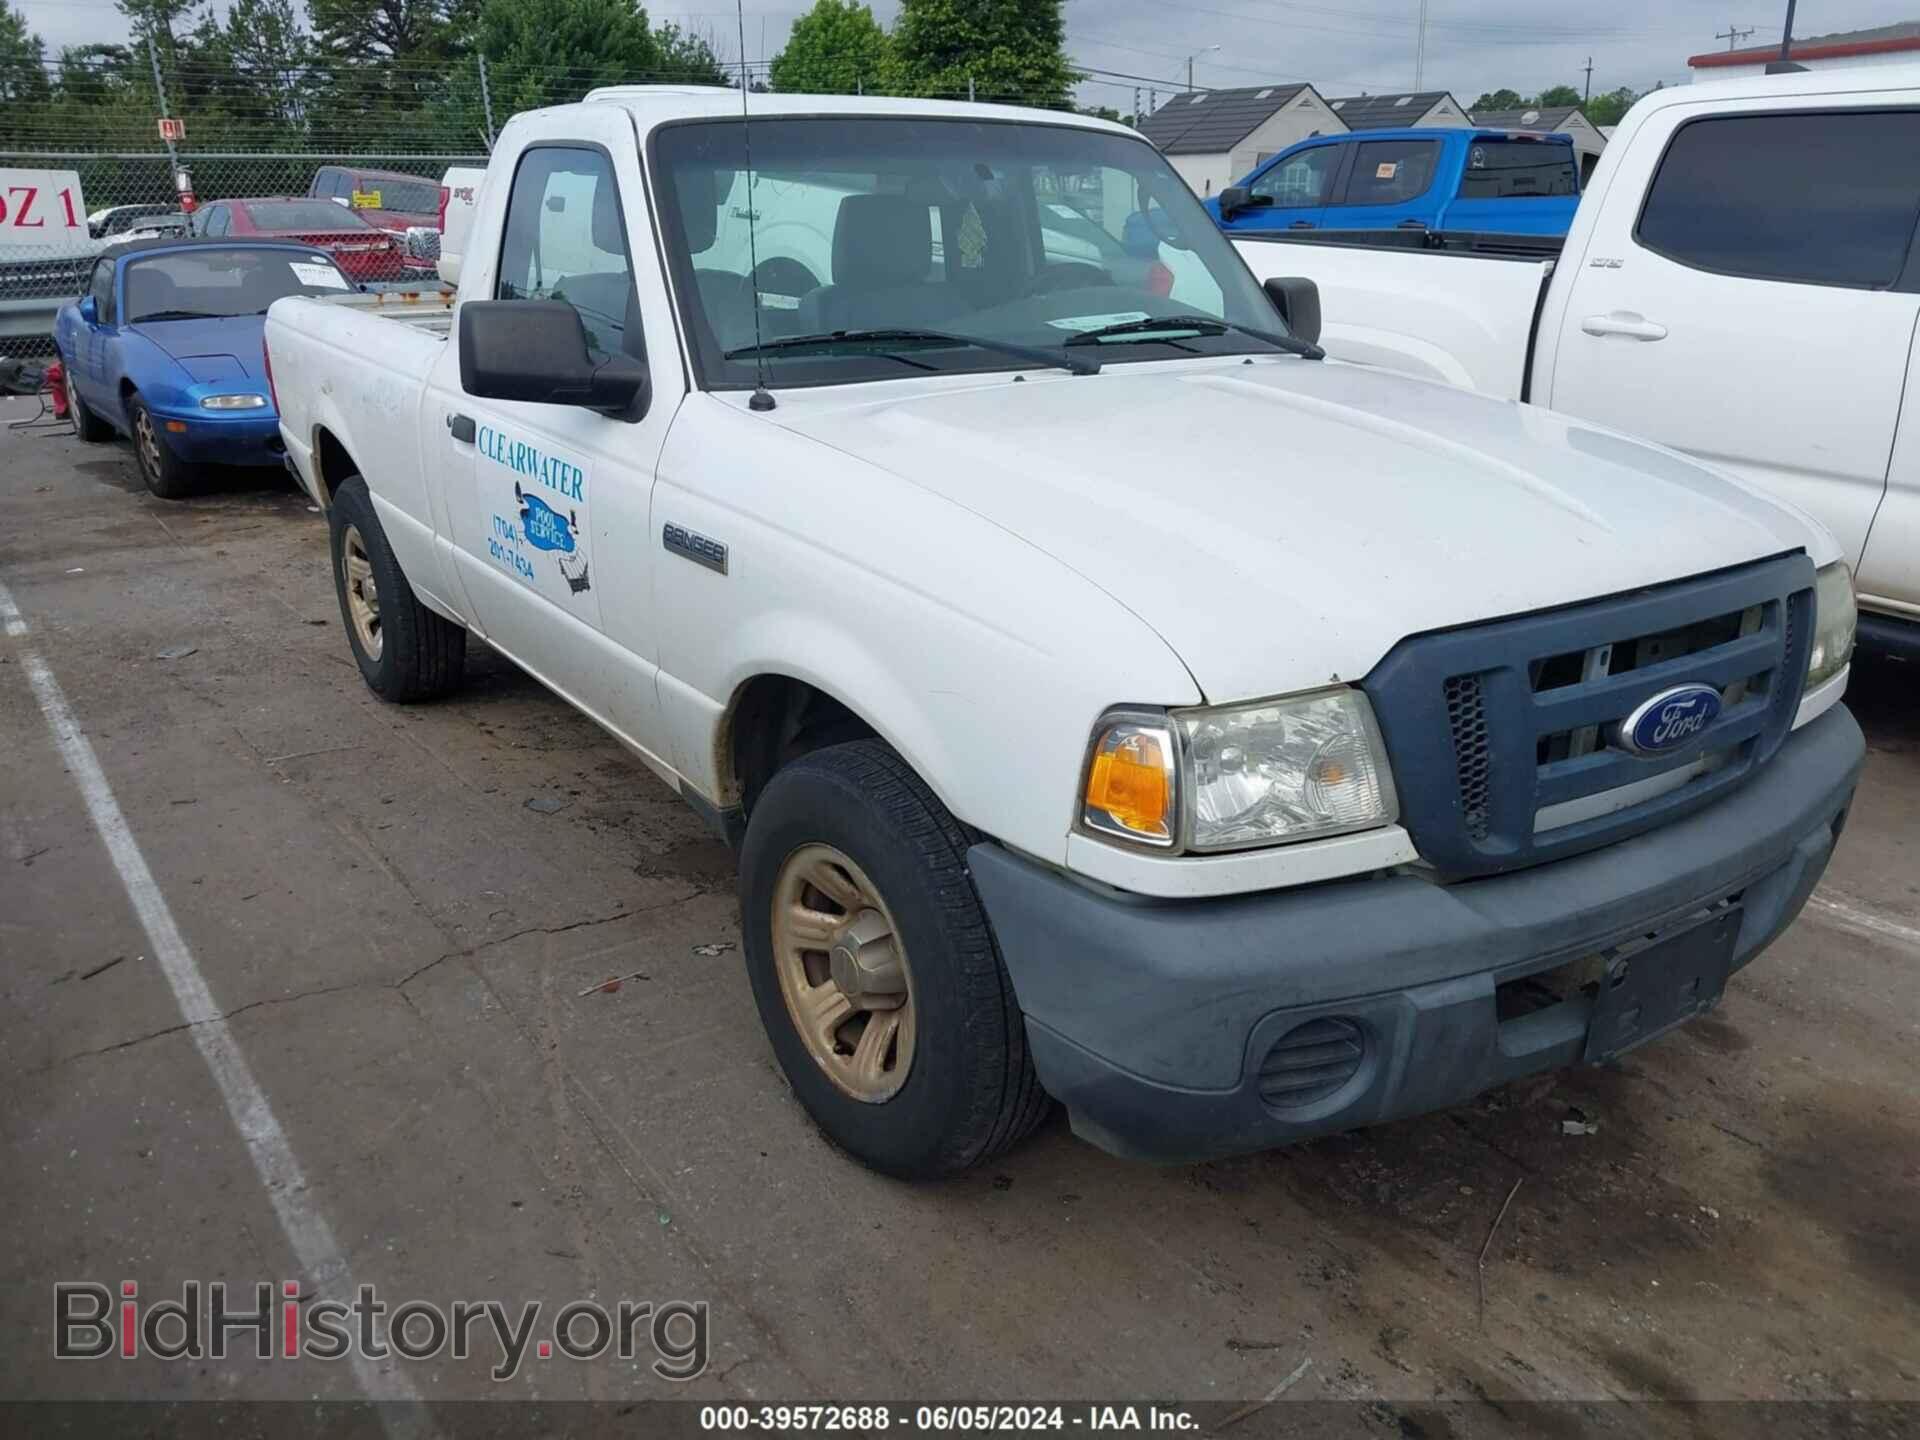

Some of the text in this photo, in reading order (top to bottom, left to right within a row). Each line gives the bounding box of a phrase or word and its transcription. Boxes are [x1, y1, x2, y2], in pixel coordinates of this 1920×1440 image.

[0, 187, 81, 228] Z 1
[479, 426, 583, 502] CLEARWATER
[535, 507, 556, 531] POOL
[663, 523, 725, 563] RANGER
[1653, 699, 1708, 743] Ford
